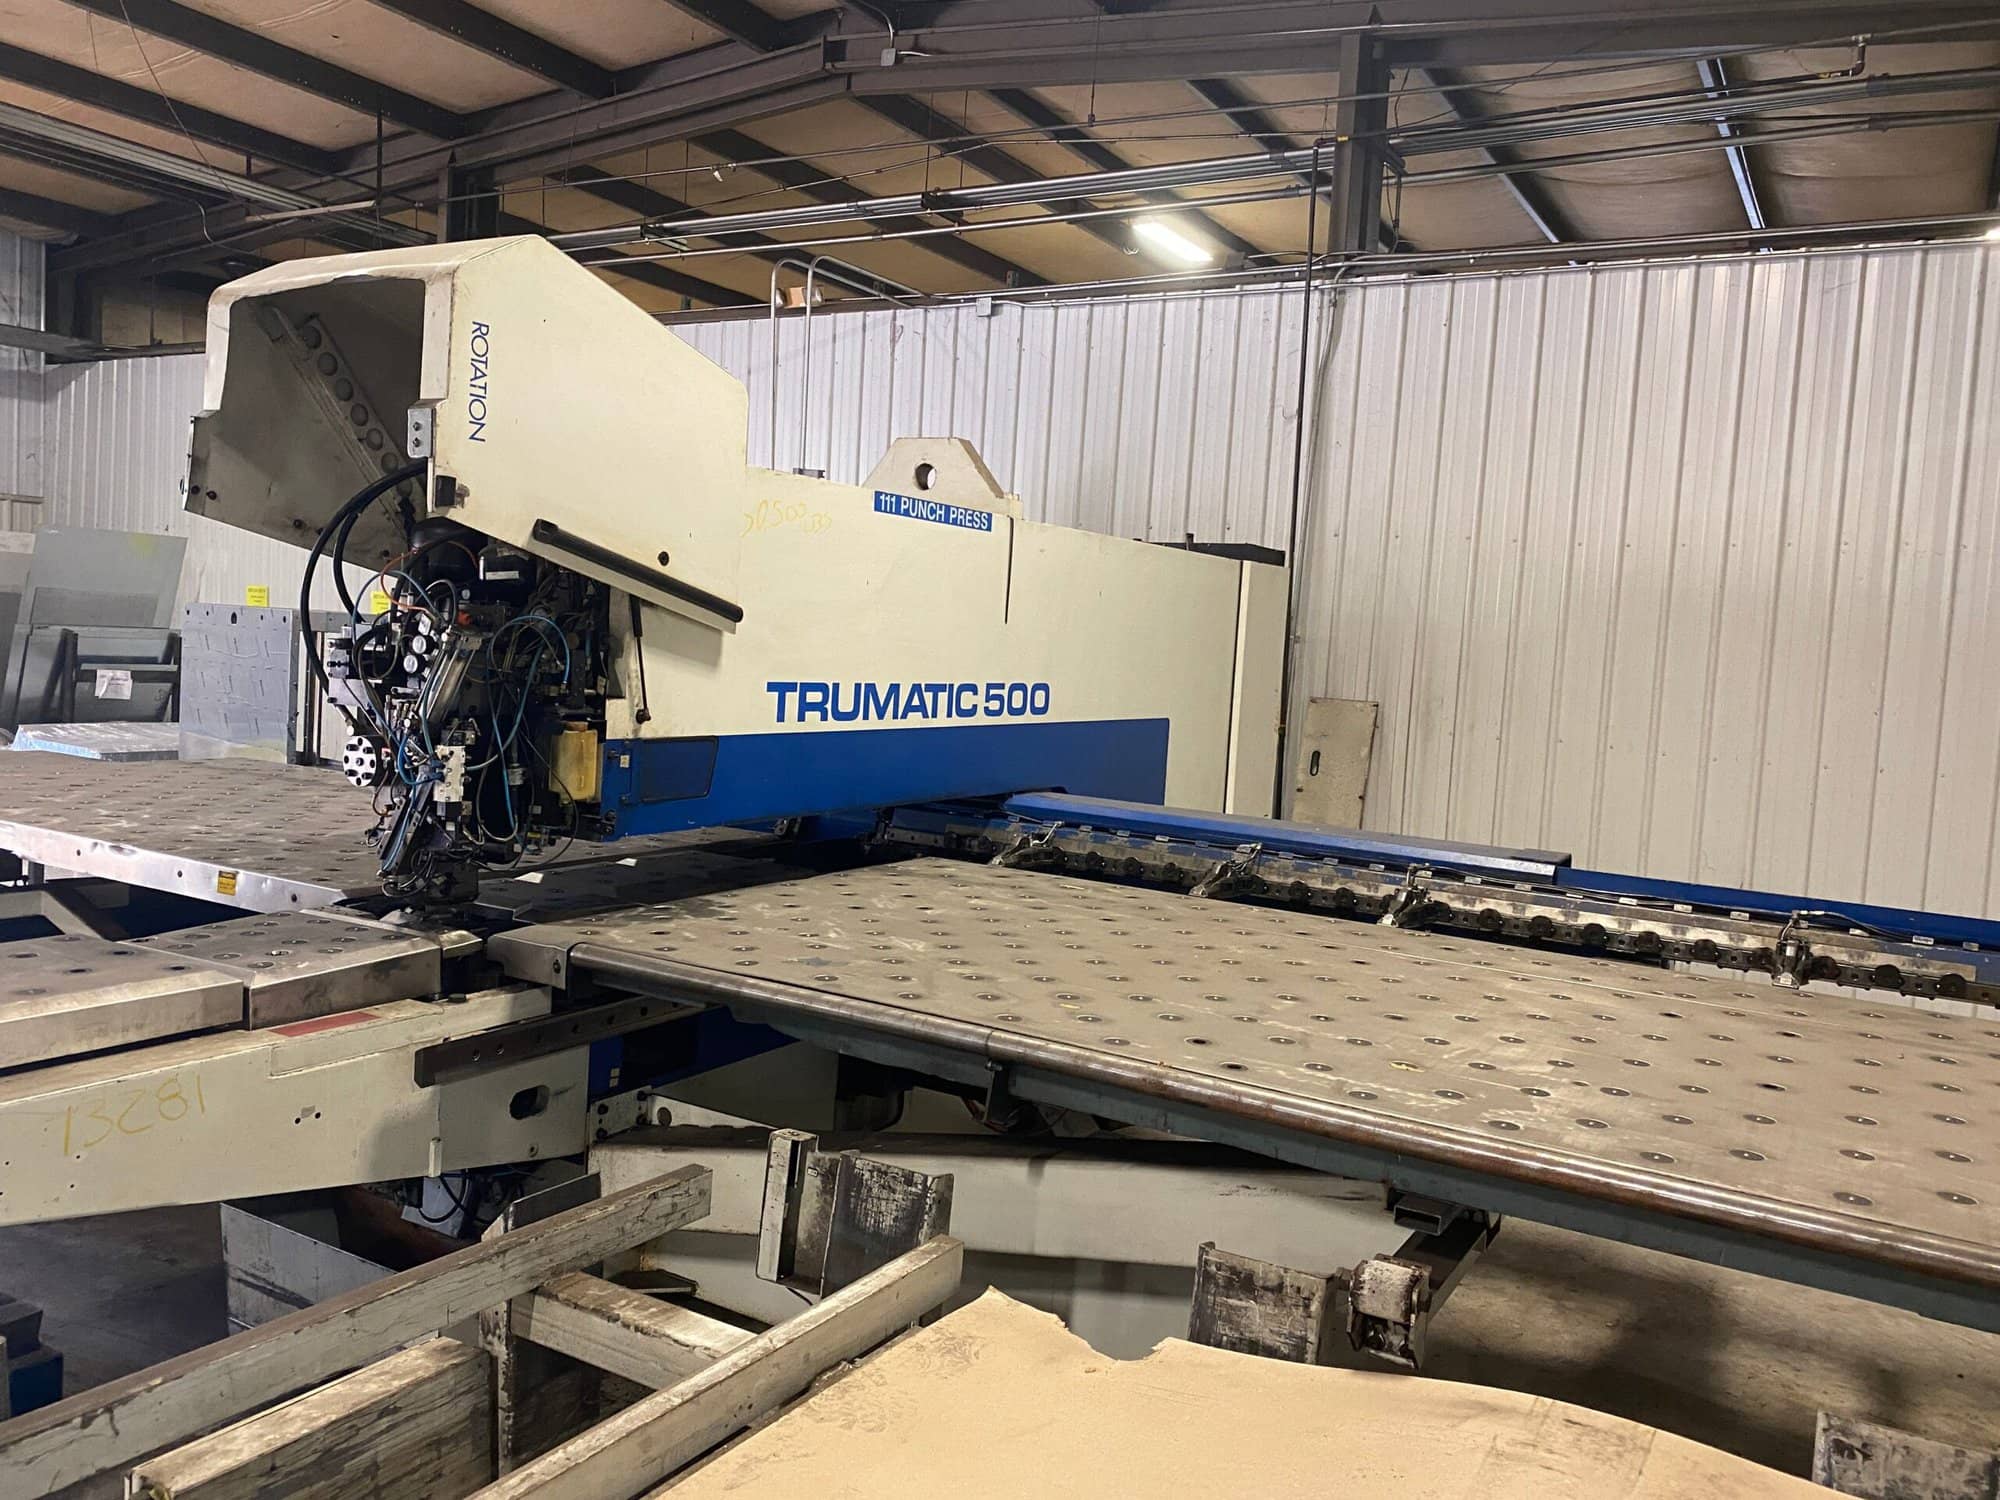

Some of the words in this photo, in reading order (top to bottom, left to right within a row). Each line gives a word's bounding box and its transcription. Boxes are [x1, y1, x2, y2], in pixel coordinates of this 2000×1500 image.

[468, 321, 490, 442] ROTATION
[880, 493, 896, 513] 111
[900, 497, 945, 522] PUNCH
[949, 506, 989, 530] PRESS
[766, 681, 978, 723] TRUMATIC
[983, 682, 1050, 717] 500
[64, 1073, 205, 1156] 13281
